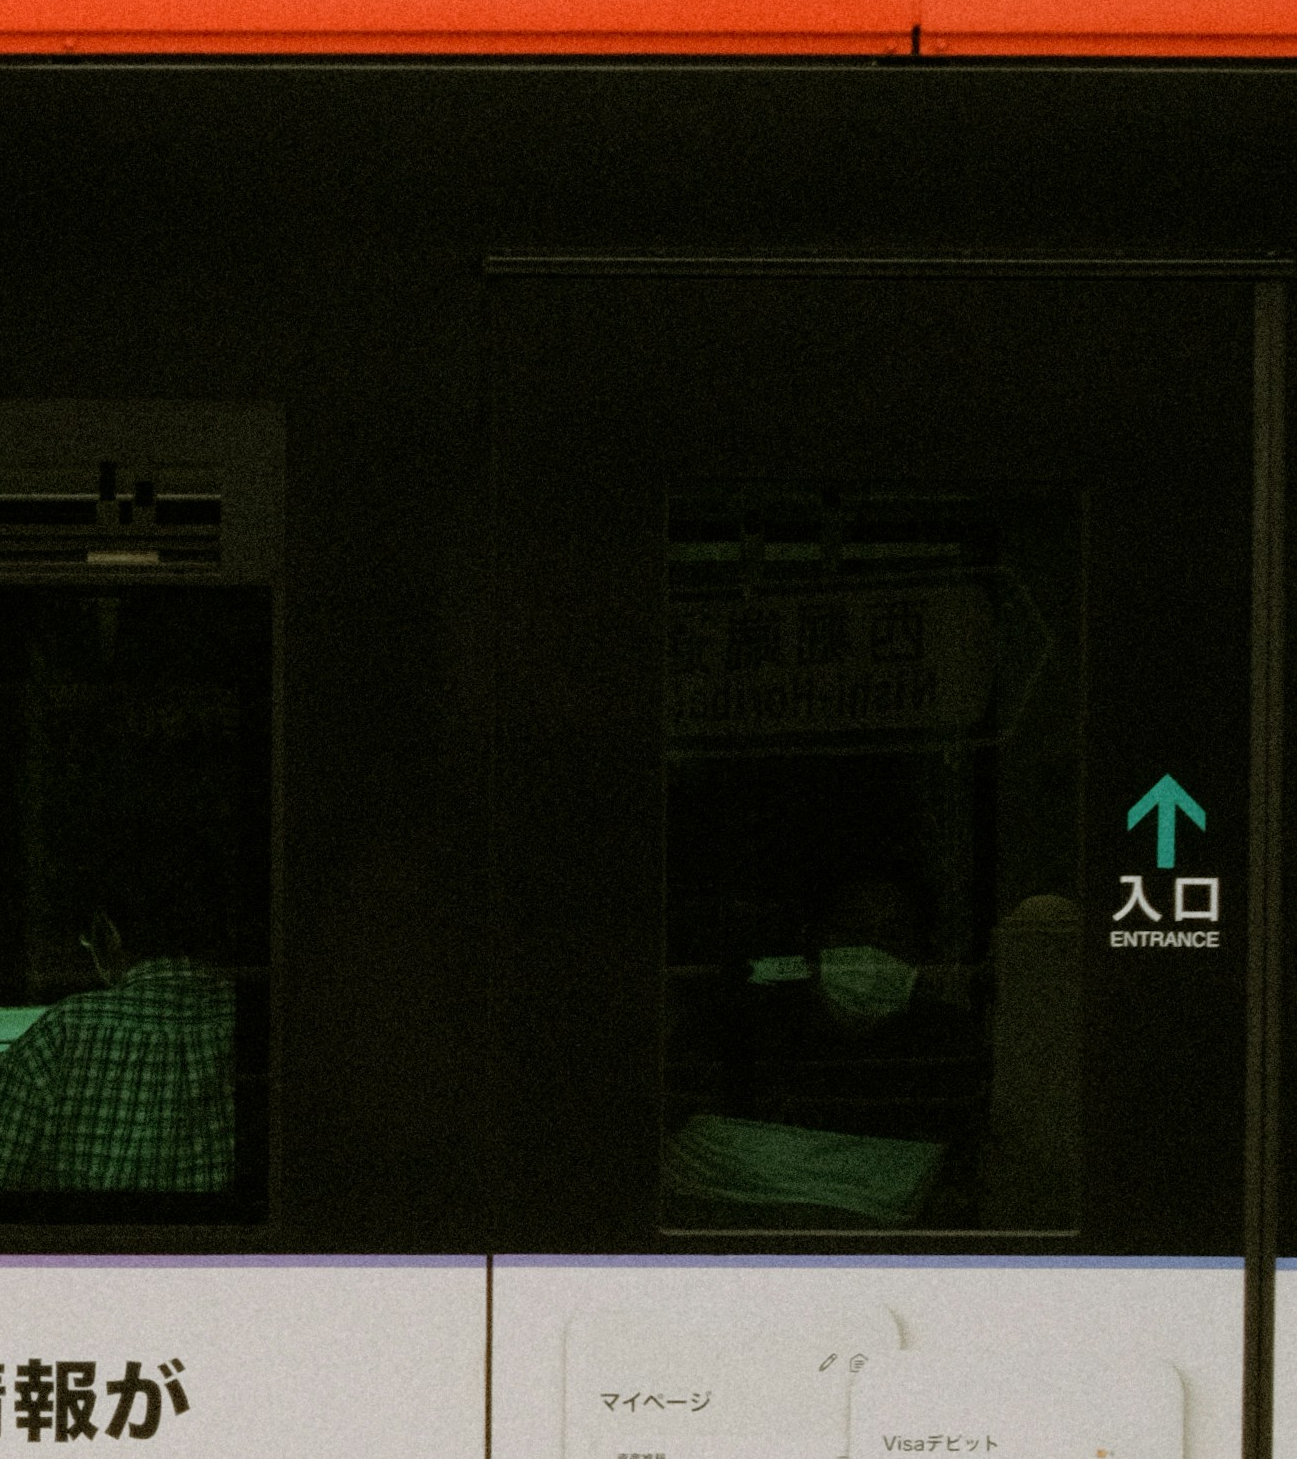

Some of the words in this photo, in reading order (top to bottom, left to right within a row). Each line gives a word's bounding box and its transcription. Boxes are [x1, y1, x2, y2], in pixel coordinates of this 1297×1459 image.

[1112, 875, 1219, 922] 入口
[1110, 930, 1220, 948] ENTRANCE
[600, 1391, 712, 1413] マイページ
[882, 1434, 999, 1453] Visaデビット
